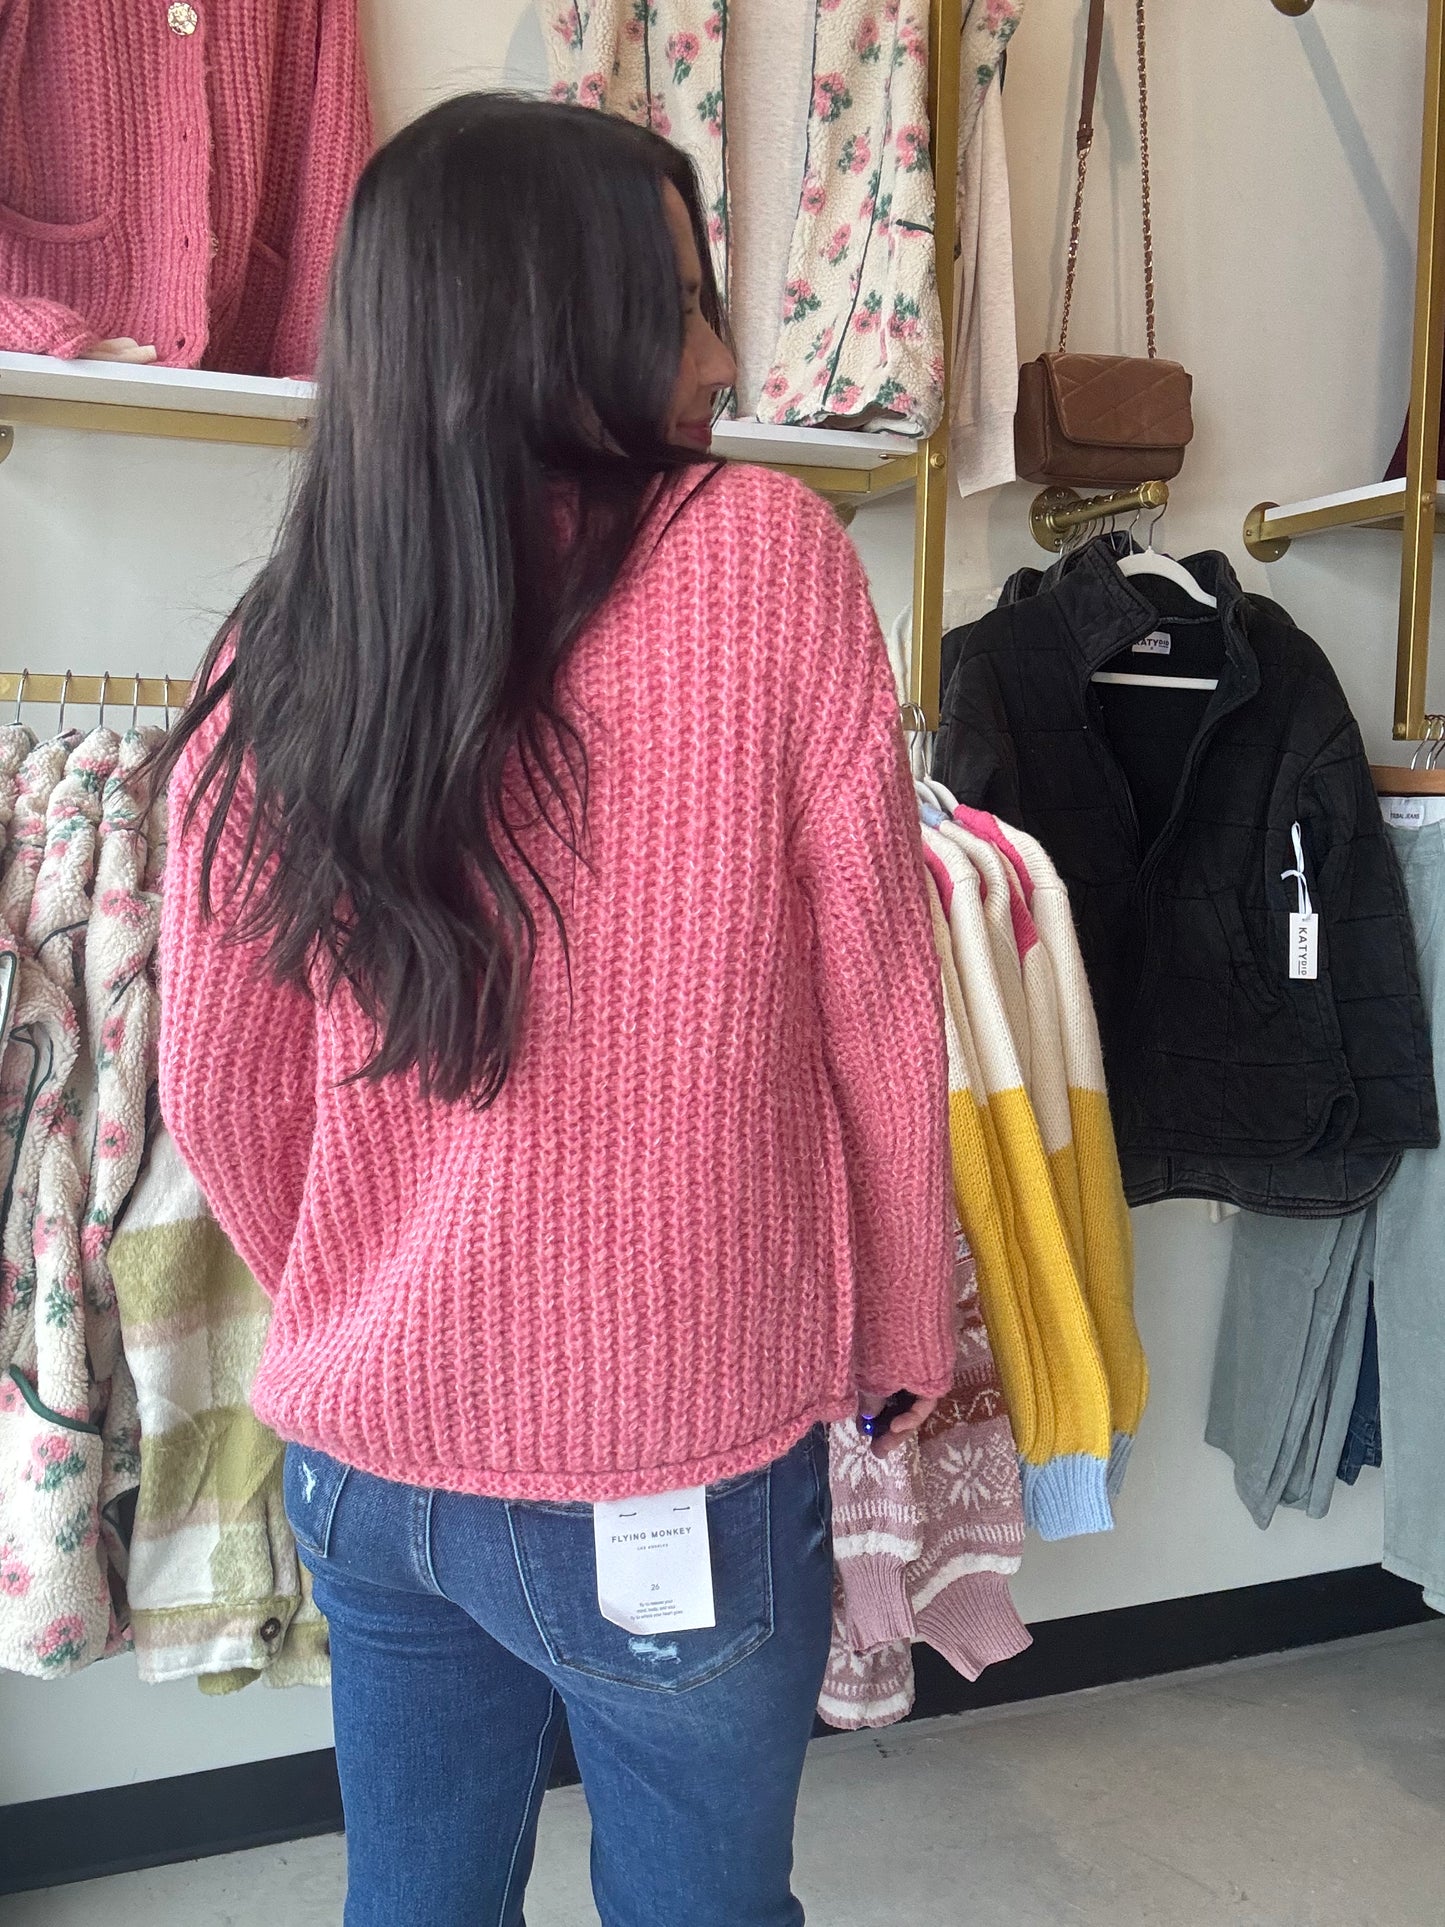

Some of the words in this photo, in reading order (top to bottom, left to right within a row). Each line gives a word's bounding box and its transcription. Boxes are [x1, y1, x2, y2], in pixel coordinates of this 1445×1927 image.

[611, 1532, 647, 1543] FLYING
[651, 1526, 692, 1538] MONKEY
[650, 1583, 660, 1591] 26
